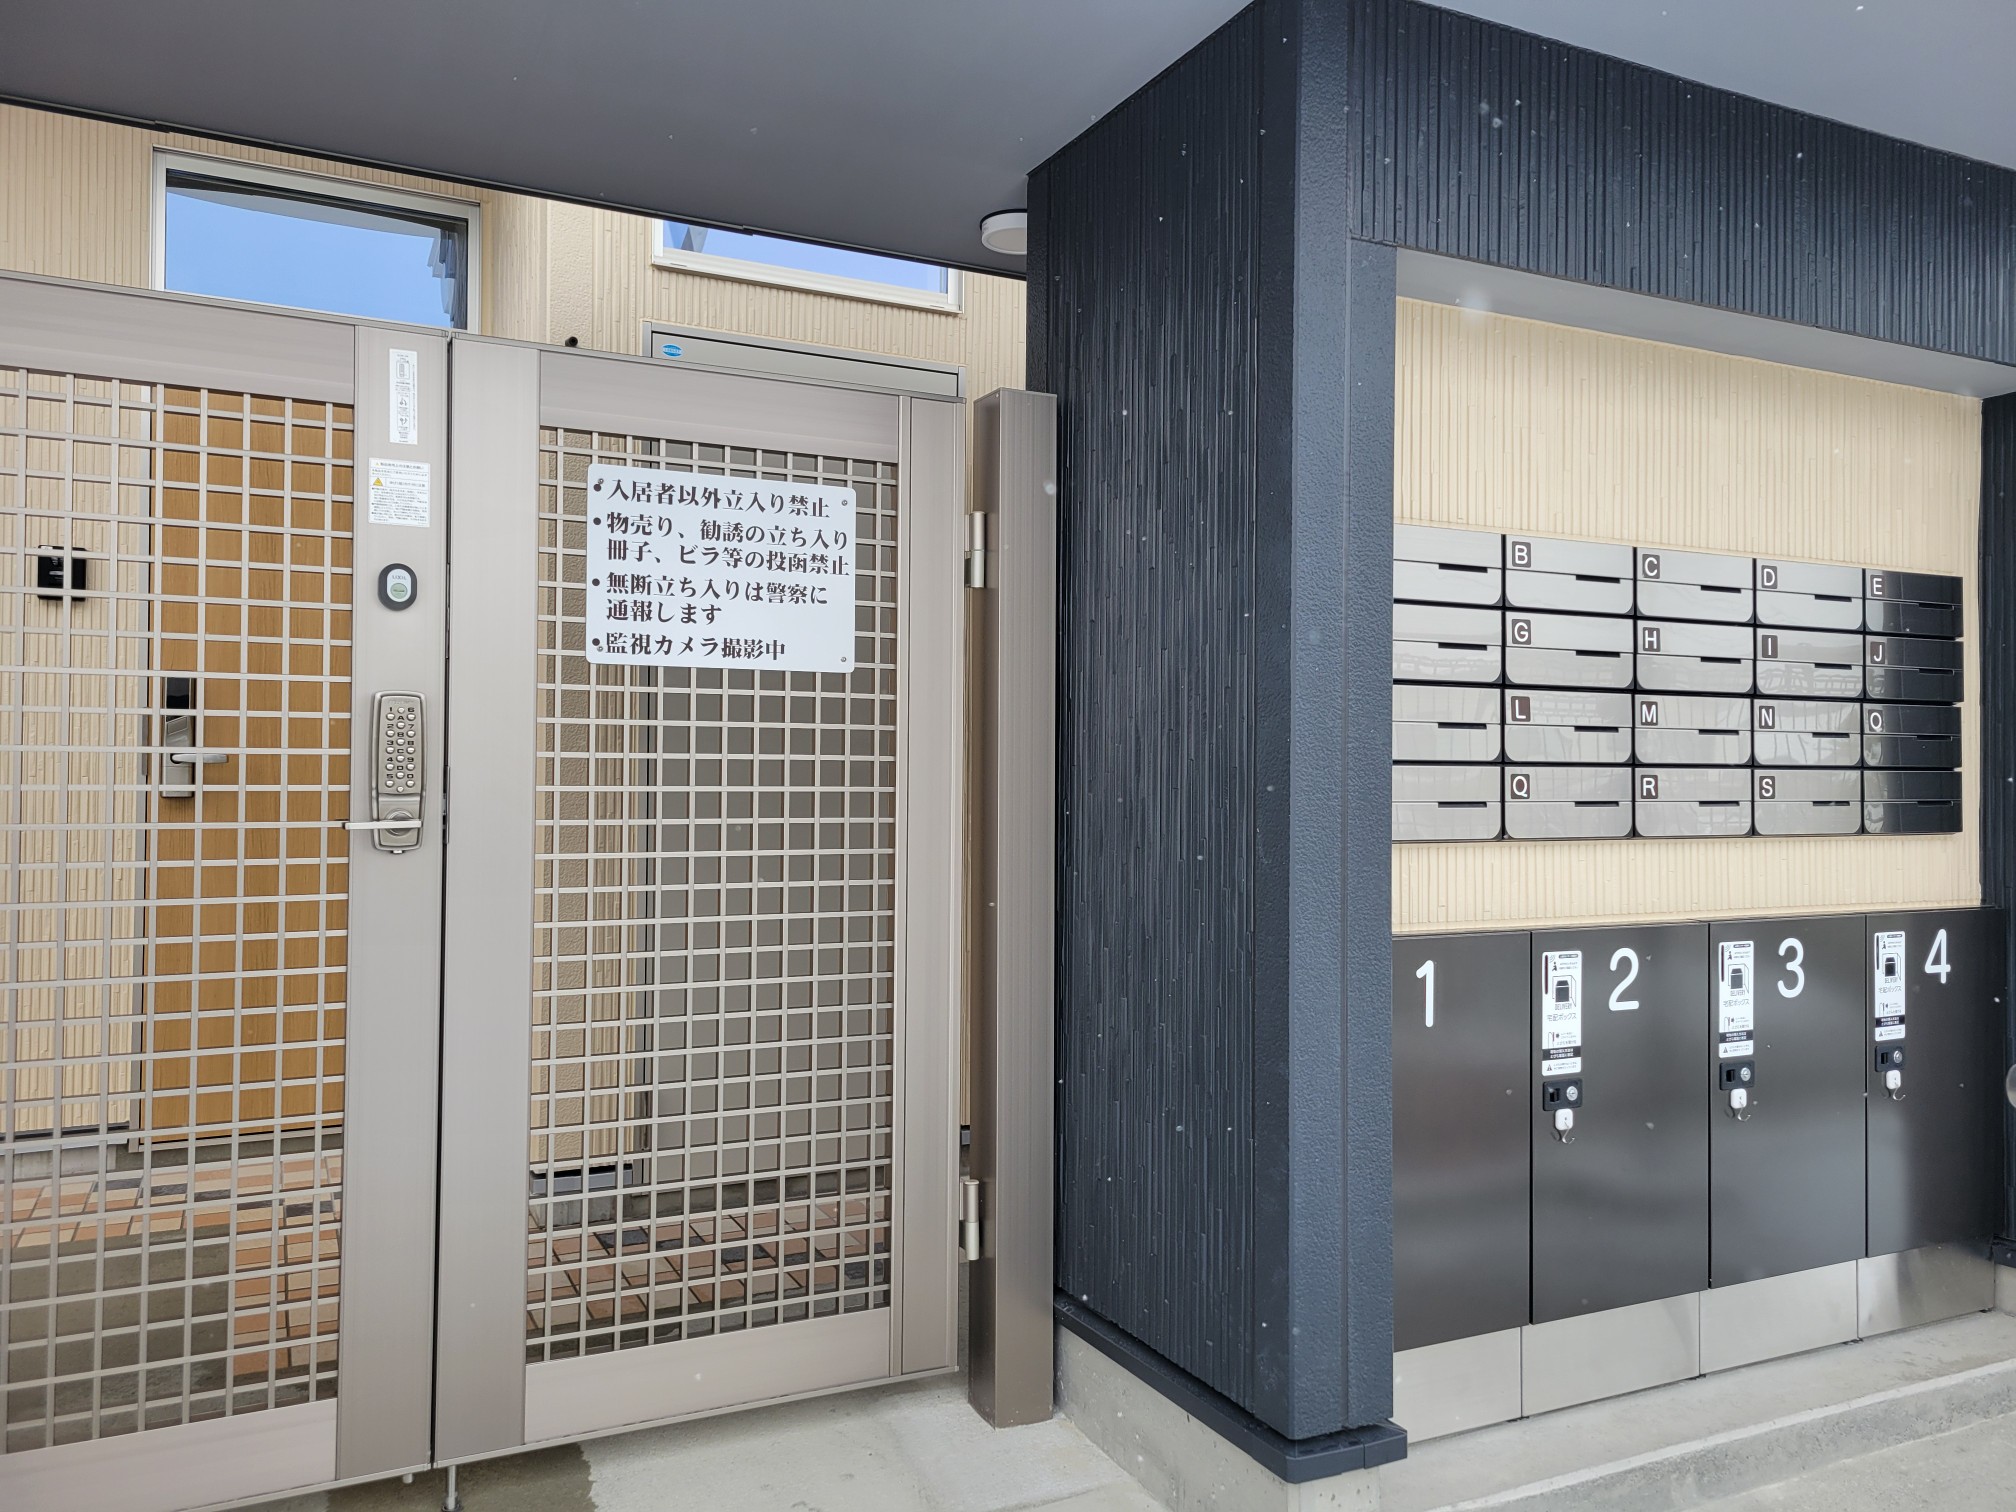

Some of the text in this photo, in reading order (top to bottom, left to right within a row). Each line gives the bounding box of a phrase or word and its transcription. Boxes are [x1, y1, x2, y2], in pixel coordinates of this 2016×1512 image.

[607, 478, 830, 519] 入居者以外立入り禁止
[606, 511, 848, 551] 物売り、勧誘の立ち入り
[607, 538, 850, 576] 冊子、ビラ等の投函禁止
[1514, 544, 1529, 565] B
[1643, 556, 1658, 577] C
[1763, 567, 1776, 587] D
[606, 571, 828, 605] 無断立ち入りは警察に
[1873, 577, 1883, 595] E
[606, 598, 723, 626] 通報します
[1513, 621, 1529, 643] G
[1644, 629, 1658, 650] H
[605, 631, 786, 661] 監視カメラ撮影中
[1873, 644, 1883, 662] J
[1514, 699, 1527, 720] L
[1641, 703, 1657, 724] M
[1761, 707, 1773, 727] N
[1512, 775, 1528, 798] Q
[1642, 777, 1656, 797] R
[1761, 778, 1774, 798] S
[1924, 928, 1952, 985] 4
[1776, 937, 1806, 999] 3
[1607, 947, 1640, 1012] 2
[1415, 959, 1435, 1028] 1
